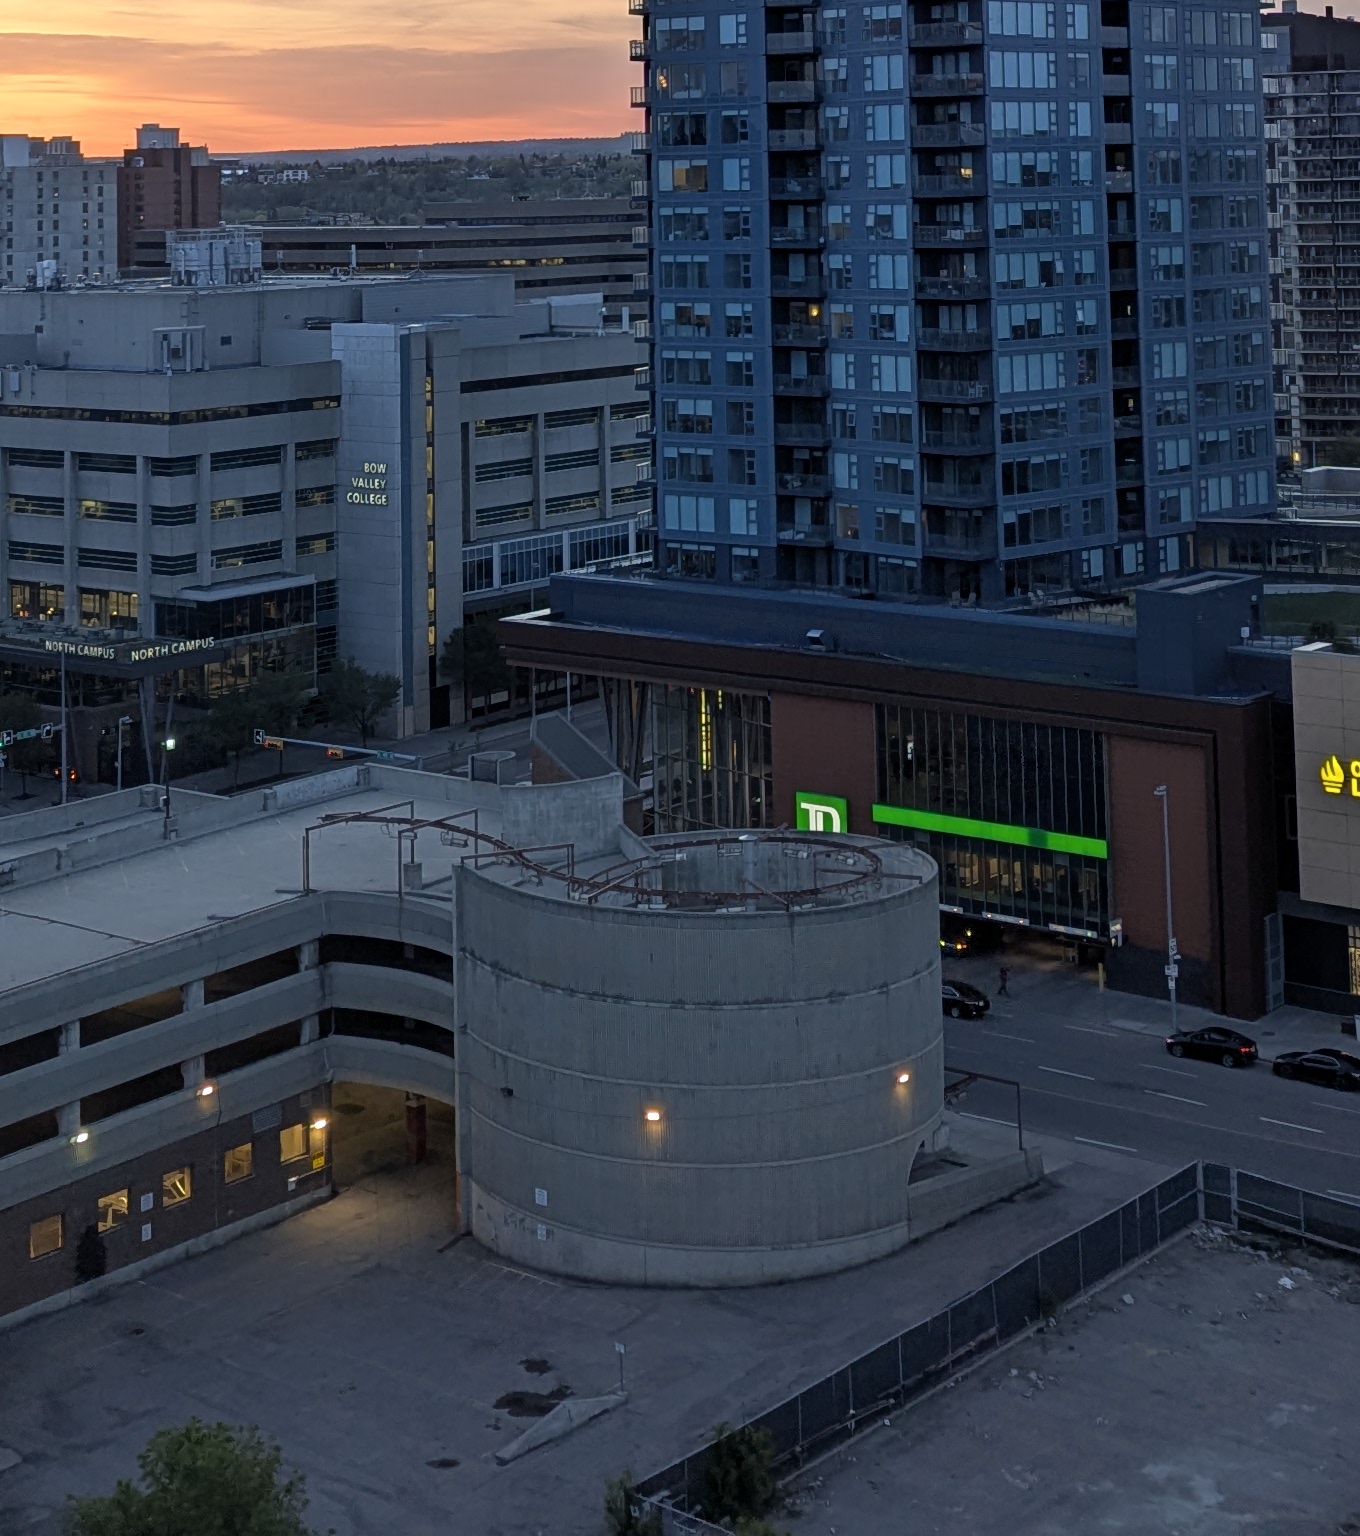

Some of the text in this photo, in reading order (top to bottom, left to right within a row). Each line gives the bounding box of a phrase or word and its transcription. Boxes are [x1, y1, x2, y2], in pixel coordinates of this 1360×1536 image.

[364, 462, 387, 473] BOW
[351, 477, 387, 489] VALLEY
[346, 492, 388, 506] COLLEGE
[45, 640, 115, 659] NORTH CAMPUS
[131, 637, 215, 661] NORTH CAMPUS
[800, 802, 841, 833] TD
